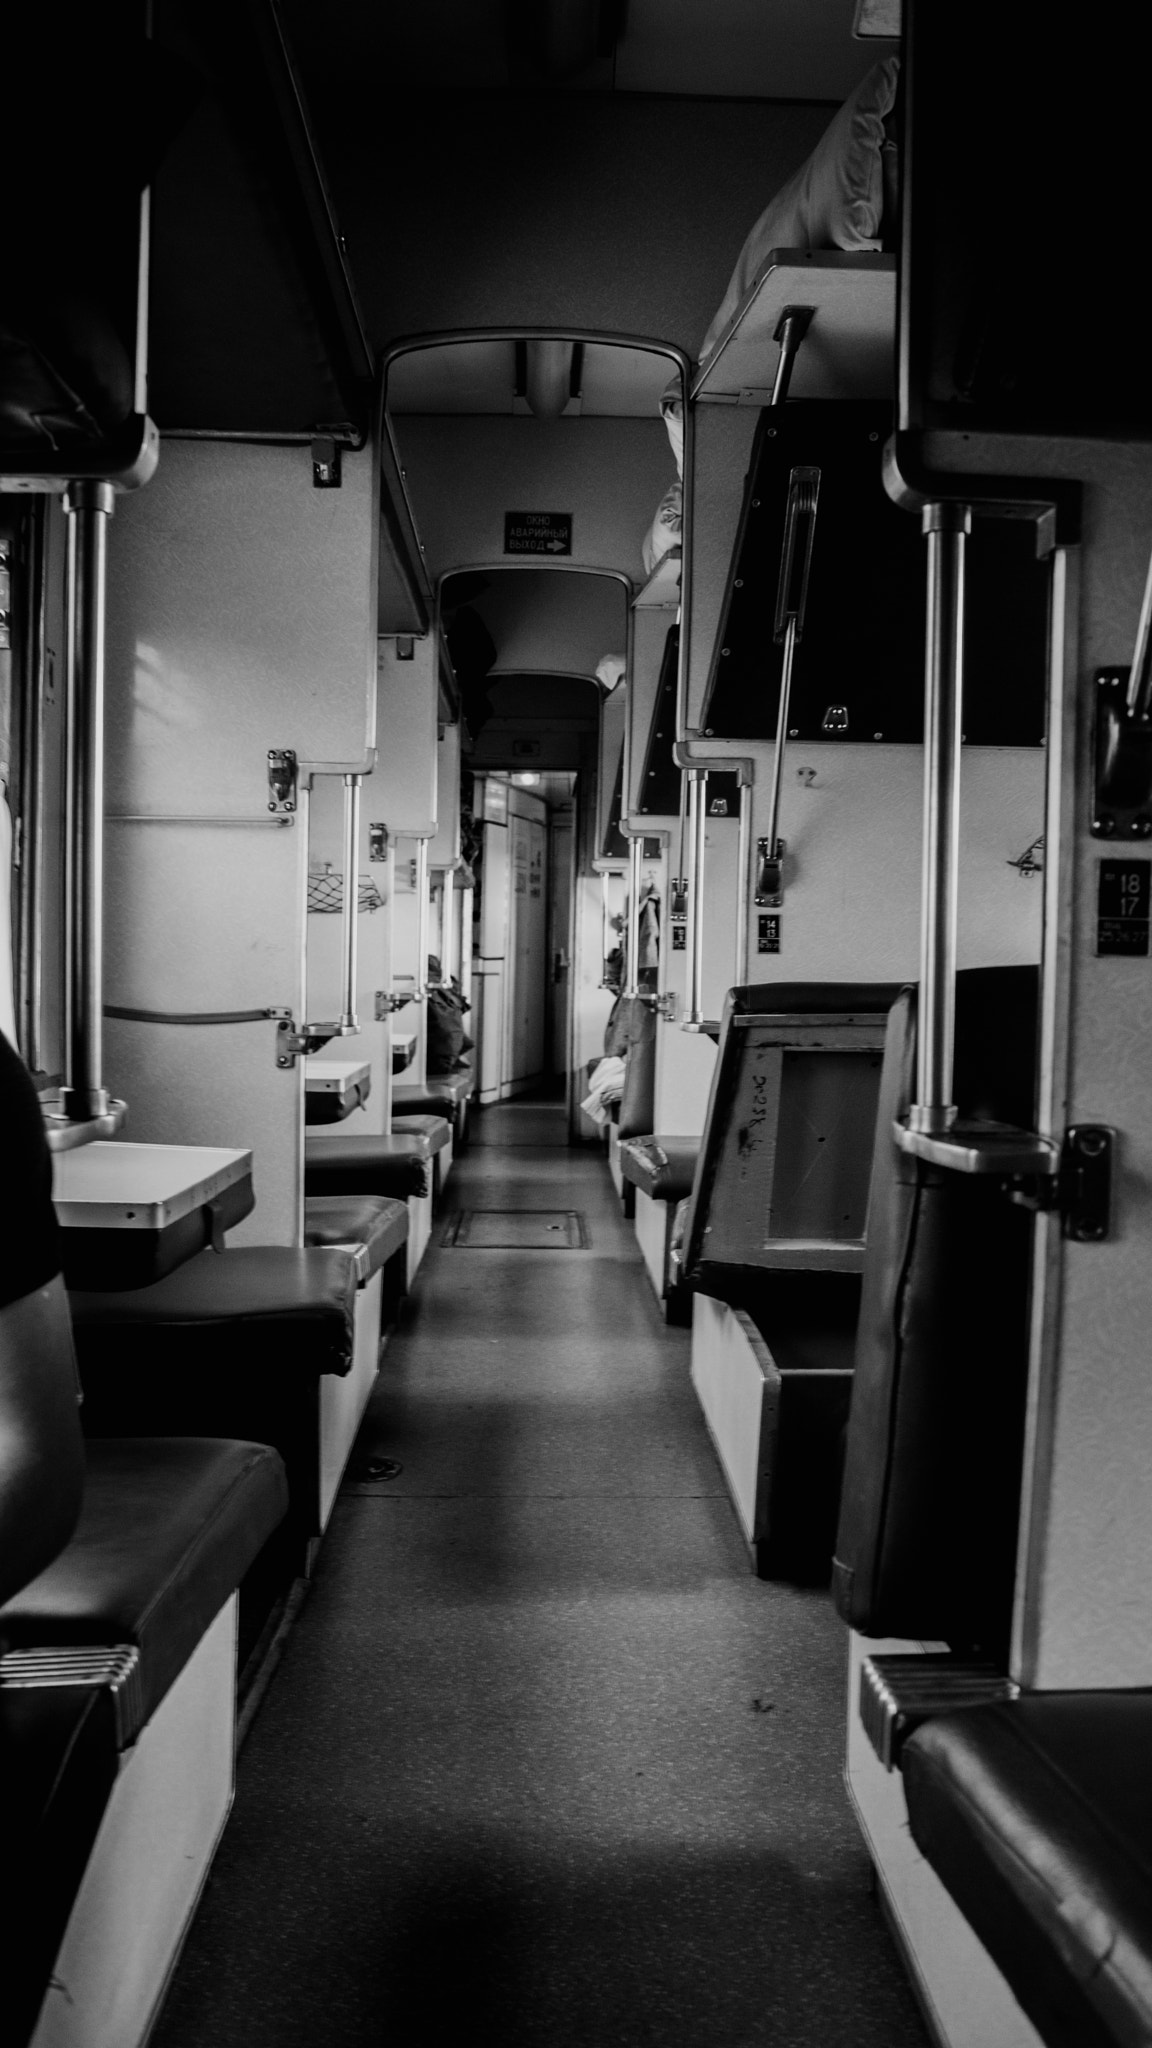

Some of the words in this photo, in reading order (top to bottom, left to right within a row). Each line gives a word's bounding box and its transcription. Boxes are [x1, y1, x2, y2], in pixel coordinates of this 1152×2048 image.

[526, 515, 551, 526] ОКНО
[510, 526, 568, 539] АВАРИЙНЫЙ
[509, 539, 546, 551] ВЫХОД
[1121, 873, 1140, 894] 18
[1121, 896, 1140, 916] 17
[766, 920, 777, 929] 14
[766, 929, 777, 938] 13
